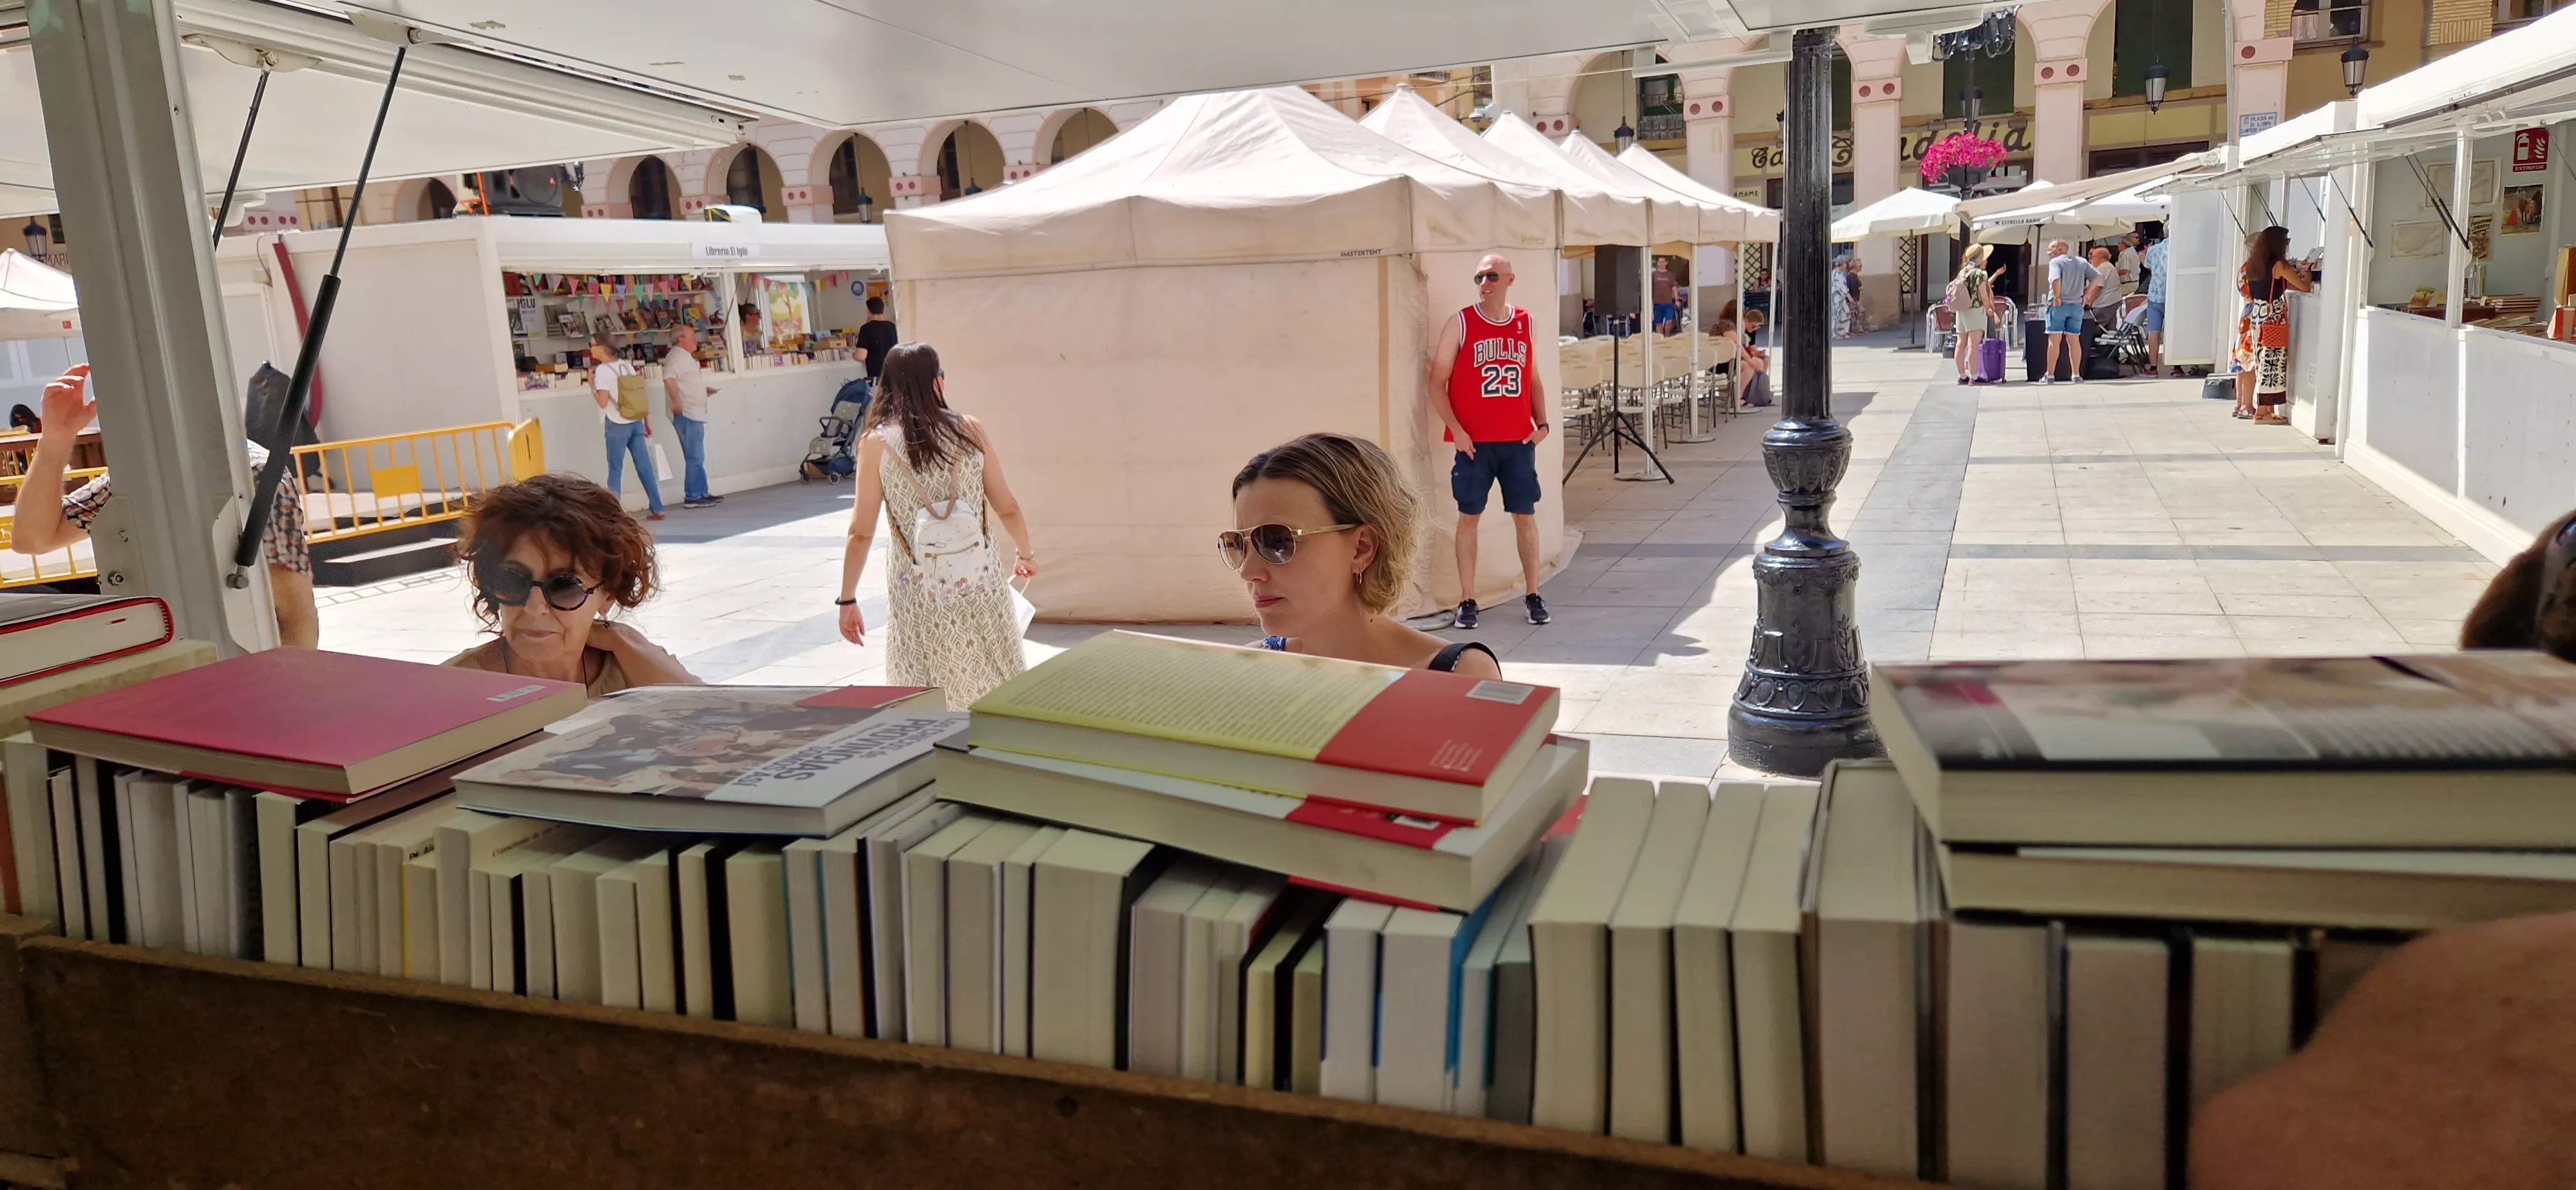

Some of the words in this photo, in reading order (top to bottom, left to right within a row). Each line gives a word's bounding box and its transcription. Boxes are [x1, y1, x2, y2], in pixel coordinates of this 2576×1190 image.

[730, 247, 735, 256] El
[1340, 249, 1382, 258] MASTERTENT
[1473, 337, 1527, 368] BULLS
[1481, 364, 1522, 398] 23
[762, 746, 832, 771] SOMOS
[773, 718, 939, 780] PROVINCIAS
[732, 771, 772, 787] ASÍ
